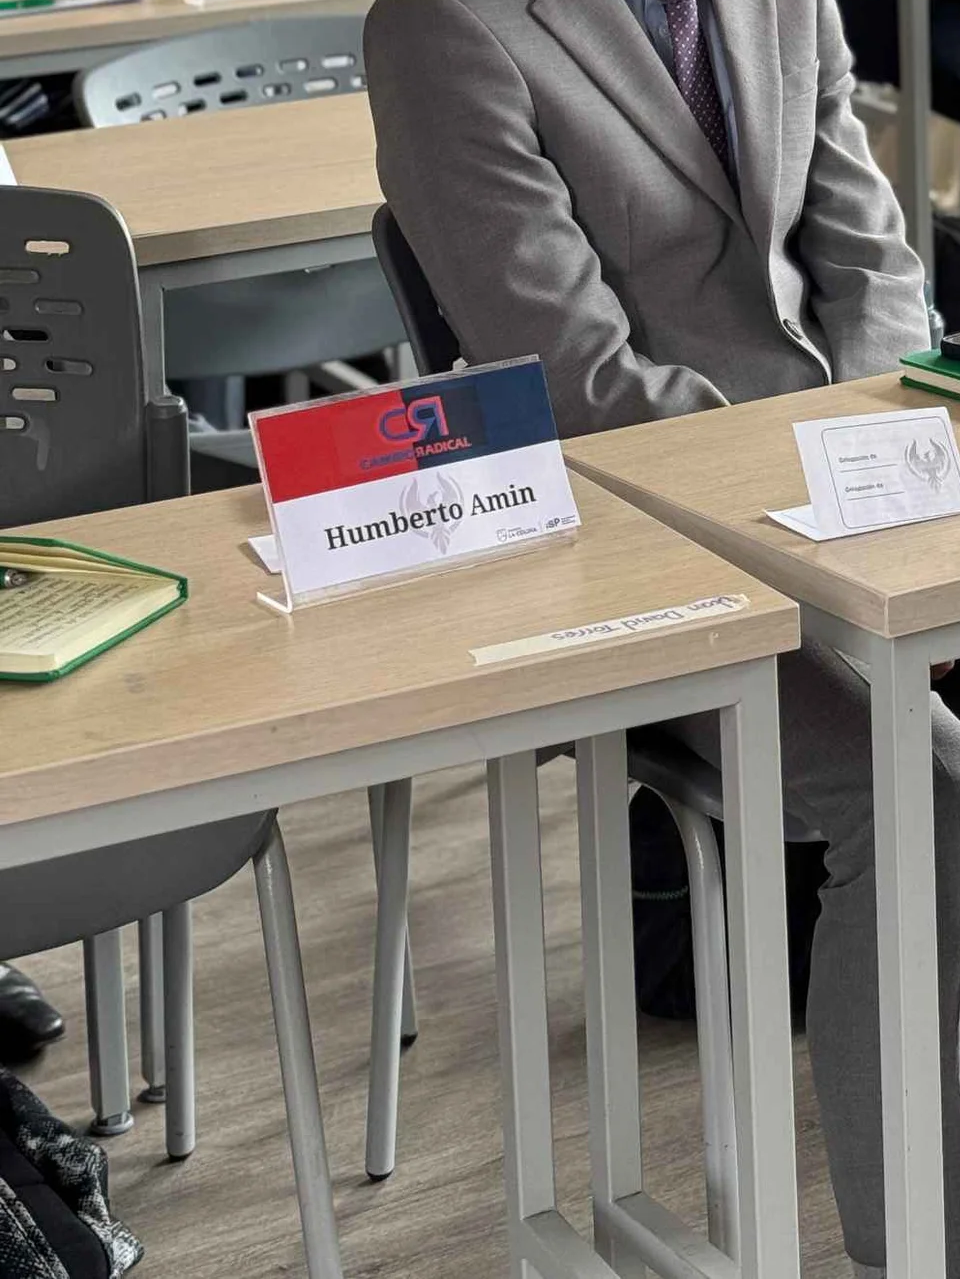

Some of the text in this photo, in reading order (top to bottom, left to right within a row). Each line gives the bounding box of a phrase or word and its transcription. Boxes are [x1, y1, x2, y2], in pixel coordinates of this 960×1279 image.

[325, 484, 537, 550] Humberto Amin
[622, 610, 684, 631] David
[551, 624, 619, 641] Torres
